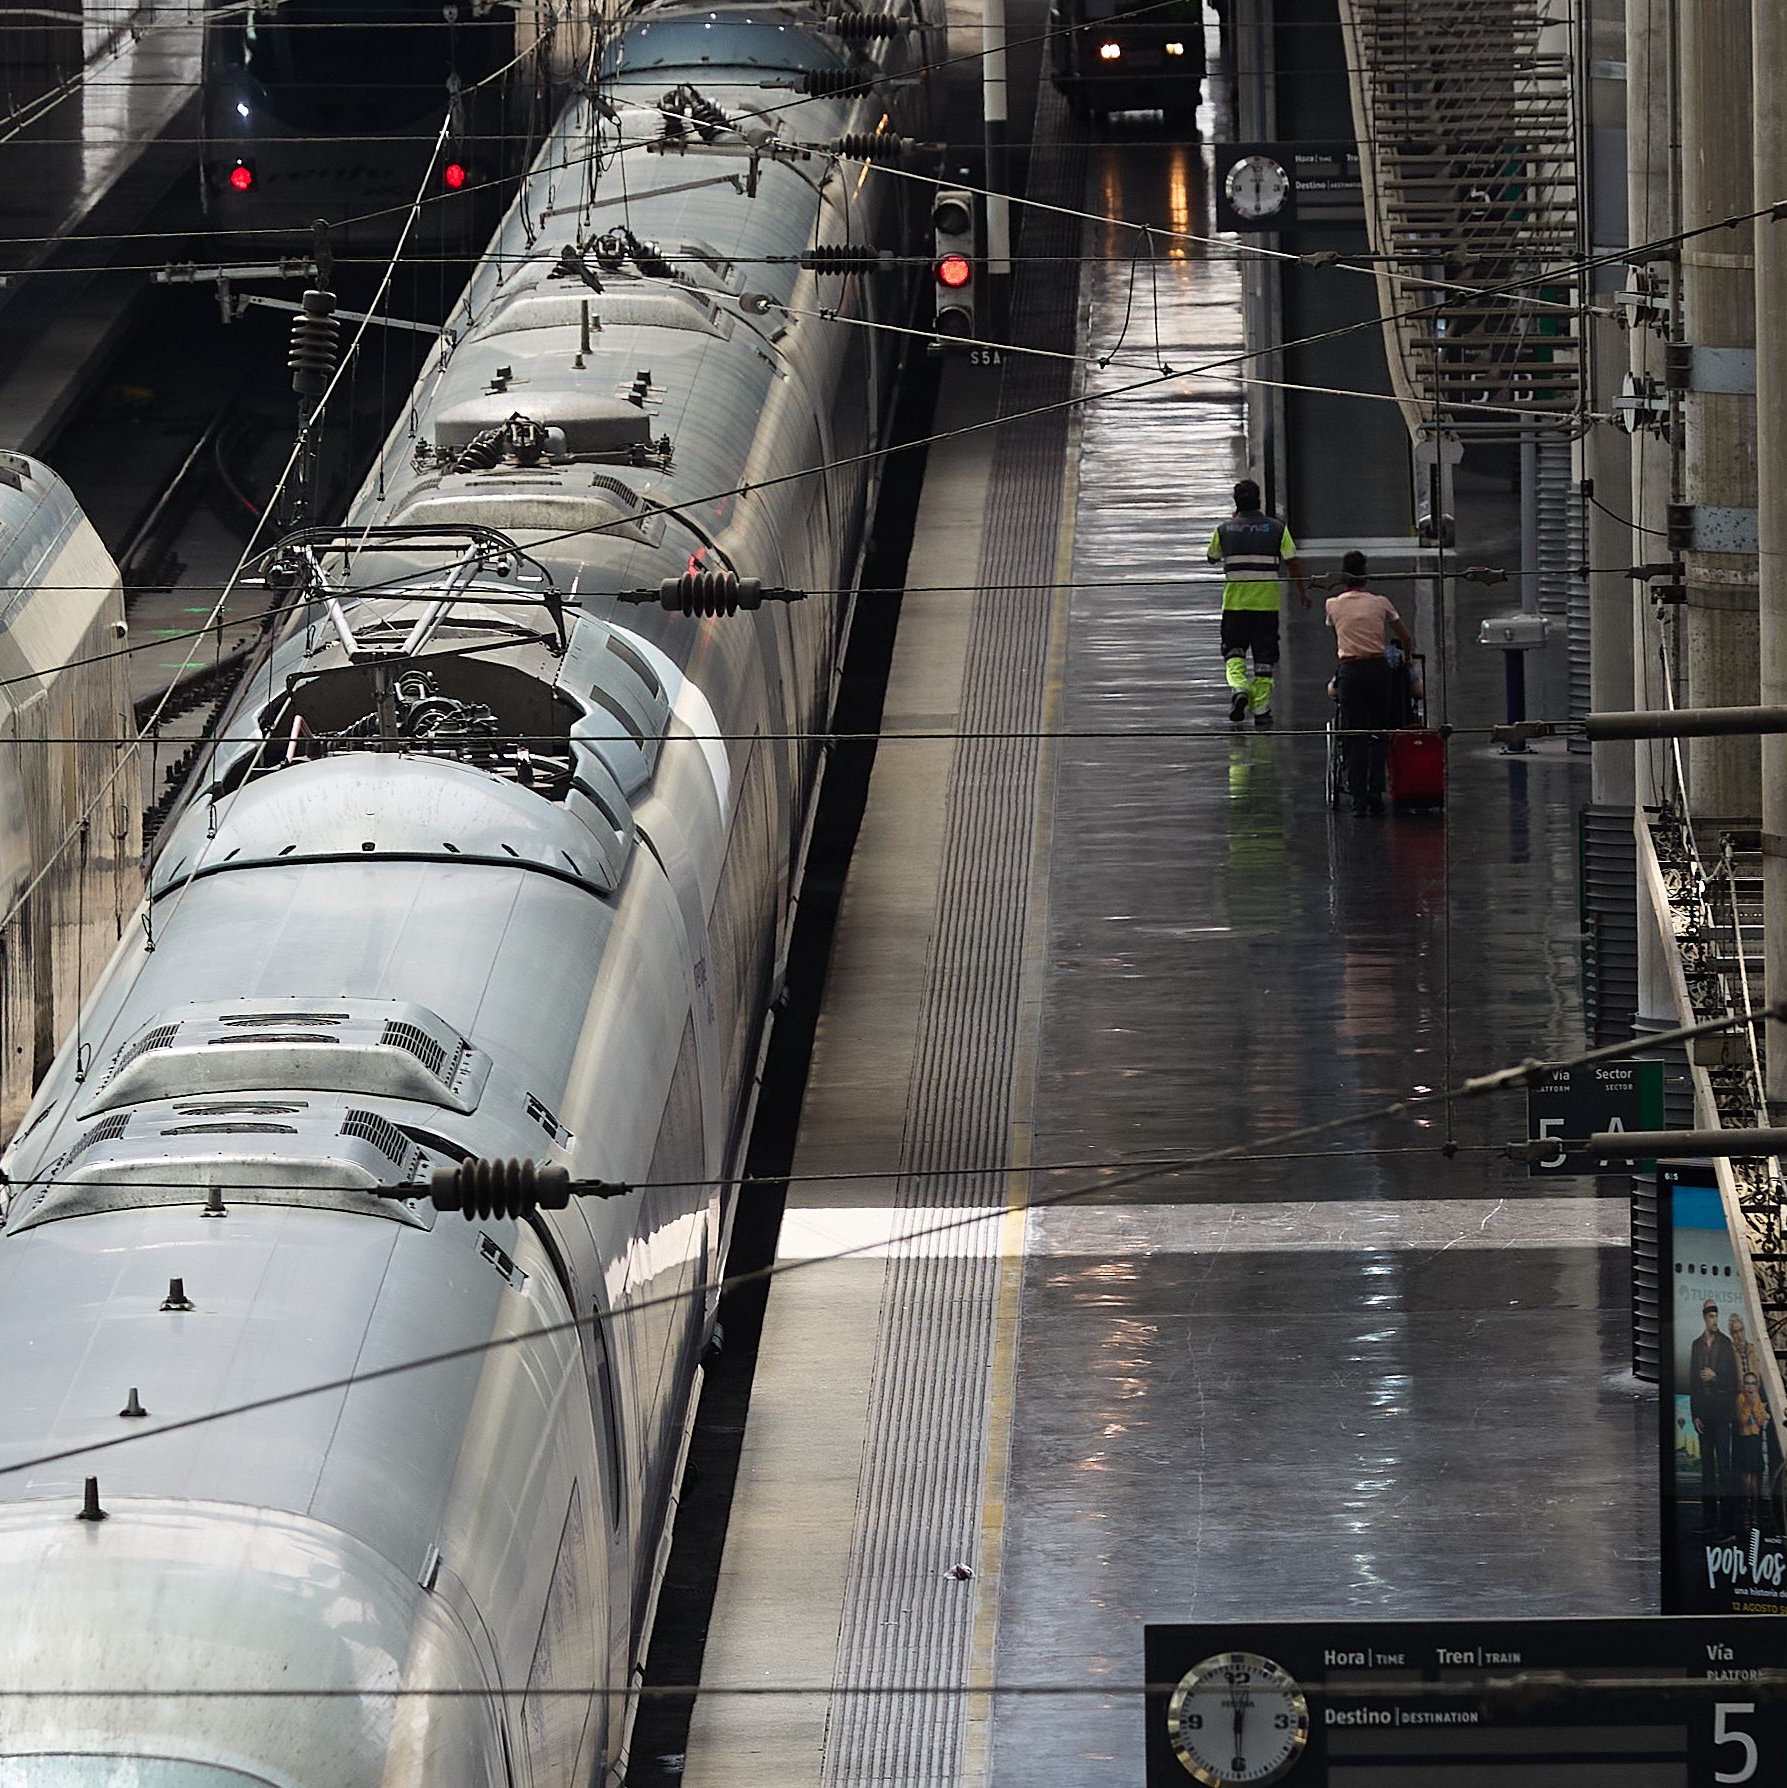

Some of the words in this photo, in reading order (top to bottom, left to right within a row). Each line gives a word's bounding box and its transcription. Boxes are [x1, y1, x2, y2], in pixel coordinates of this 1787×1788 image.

[969, 350, 1002, 366] S5A
[1595, 1068, 1634, 1081] Sector
[1539, 1118, 1568, 1168] 5
[1705, 1545, 1749, 1591] por
[1743, 1602, 1778, 1614] AGOSTO
[1323, 1649, 1365, 1666] Hora
[1375, 1654, 1406, 1665] TIME
[1435, 1648, 1475, 1665] Tren
[1484, 1652, 1522, 1664] TRAIN
[1705, 1642, 1735, 1662] Vía
[1705, 1669, 1762, 1682] PLATFOR
[1187, 1714, 1203, 1730] 9
[1274, 1713, 1290, 1730] 3
[1323, 1705, 1392, 1725] Destino
[1400, 1711, 1479, 1724] DESTINATION
[1713, 1702, 1759, 1785] 5
[1231, 1756, 1247, 1772] 6
